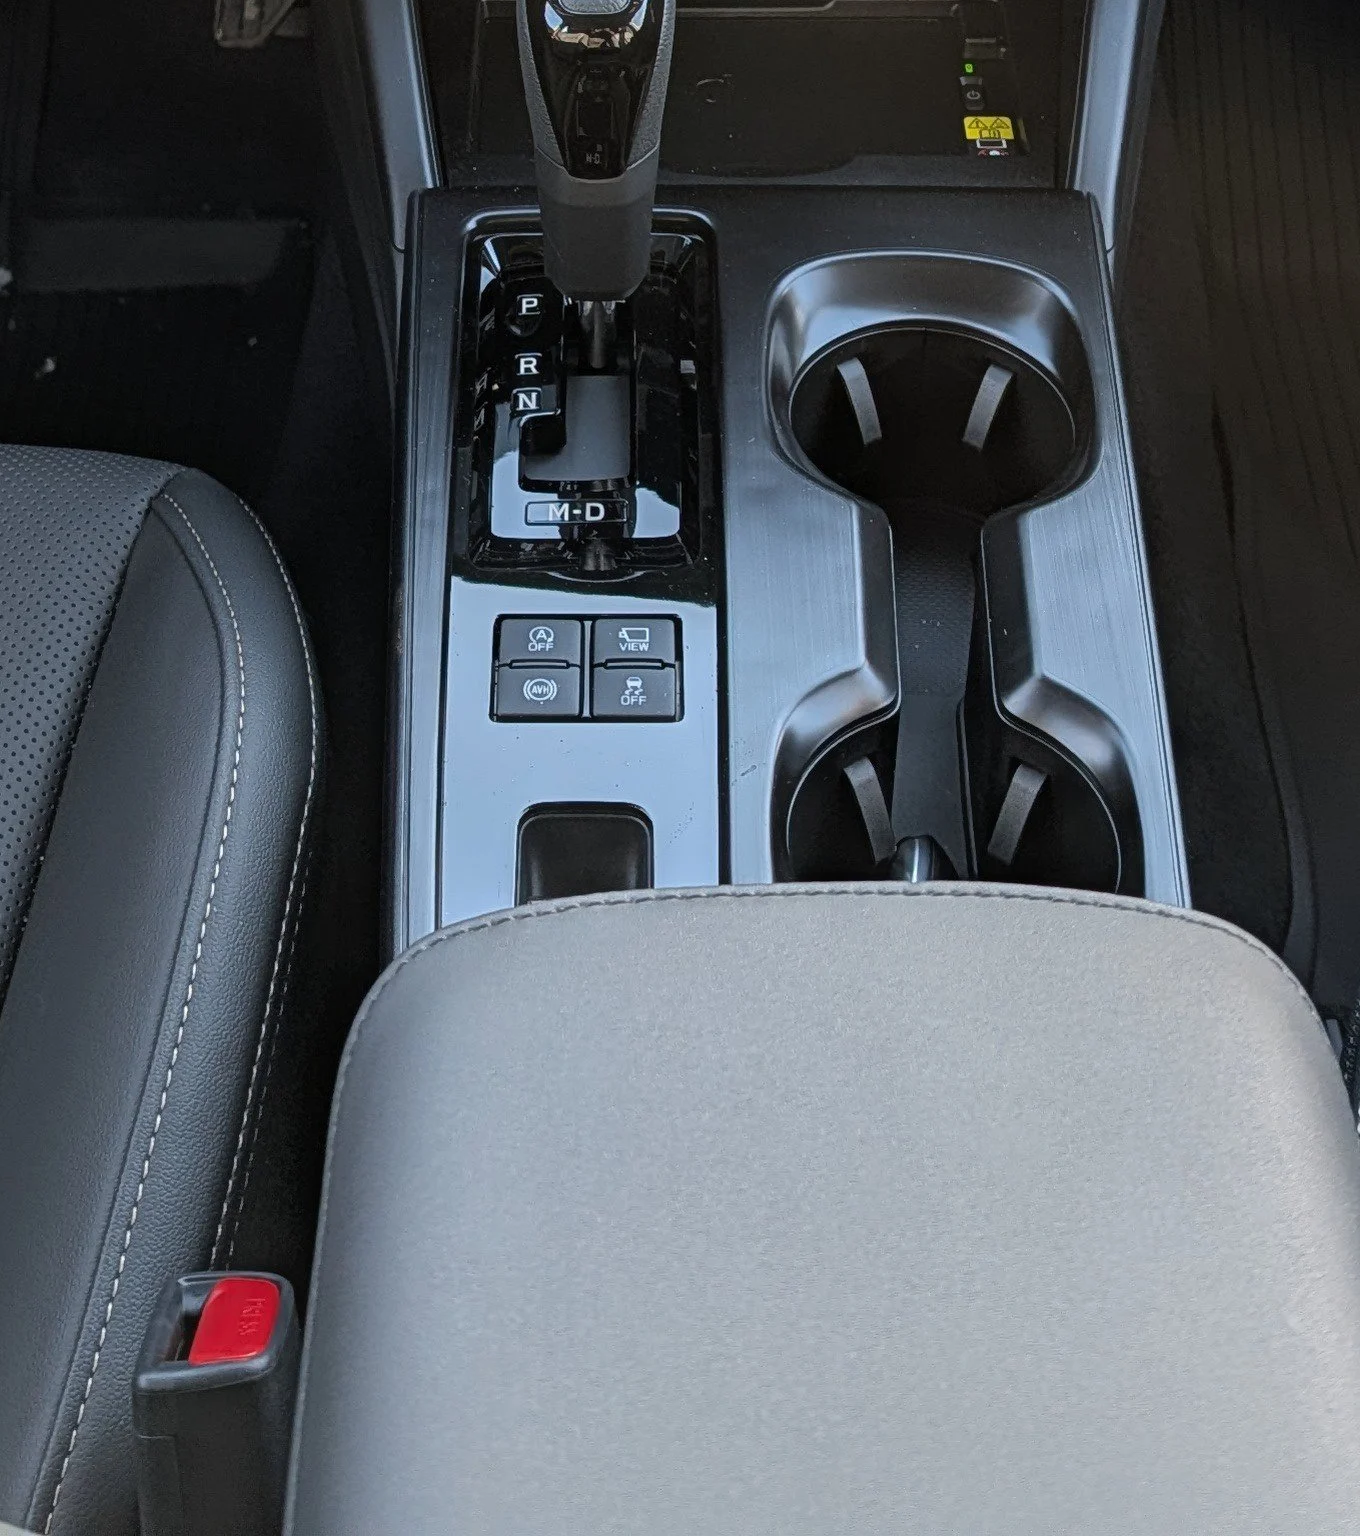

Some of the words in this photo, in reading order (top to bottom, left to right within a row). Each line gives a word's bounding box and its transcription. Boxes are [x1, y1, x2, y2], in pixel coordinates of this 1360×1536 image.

[521, 297, 538, 314] P
[519, 357, 539, 375] R
[517, 392, 537, 410] N
[547, 502, 605, 522] M-D
[528, 642, 554, 652] OFF
[619, 643, 649, 652] VIEW
[532, 684, 549, 695] AVH
[620, 695, 647, 705] OFF
